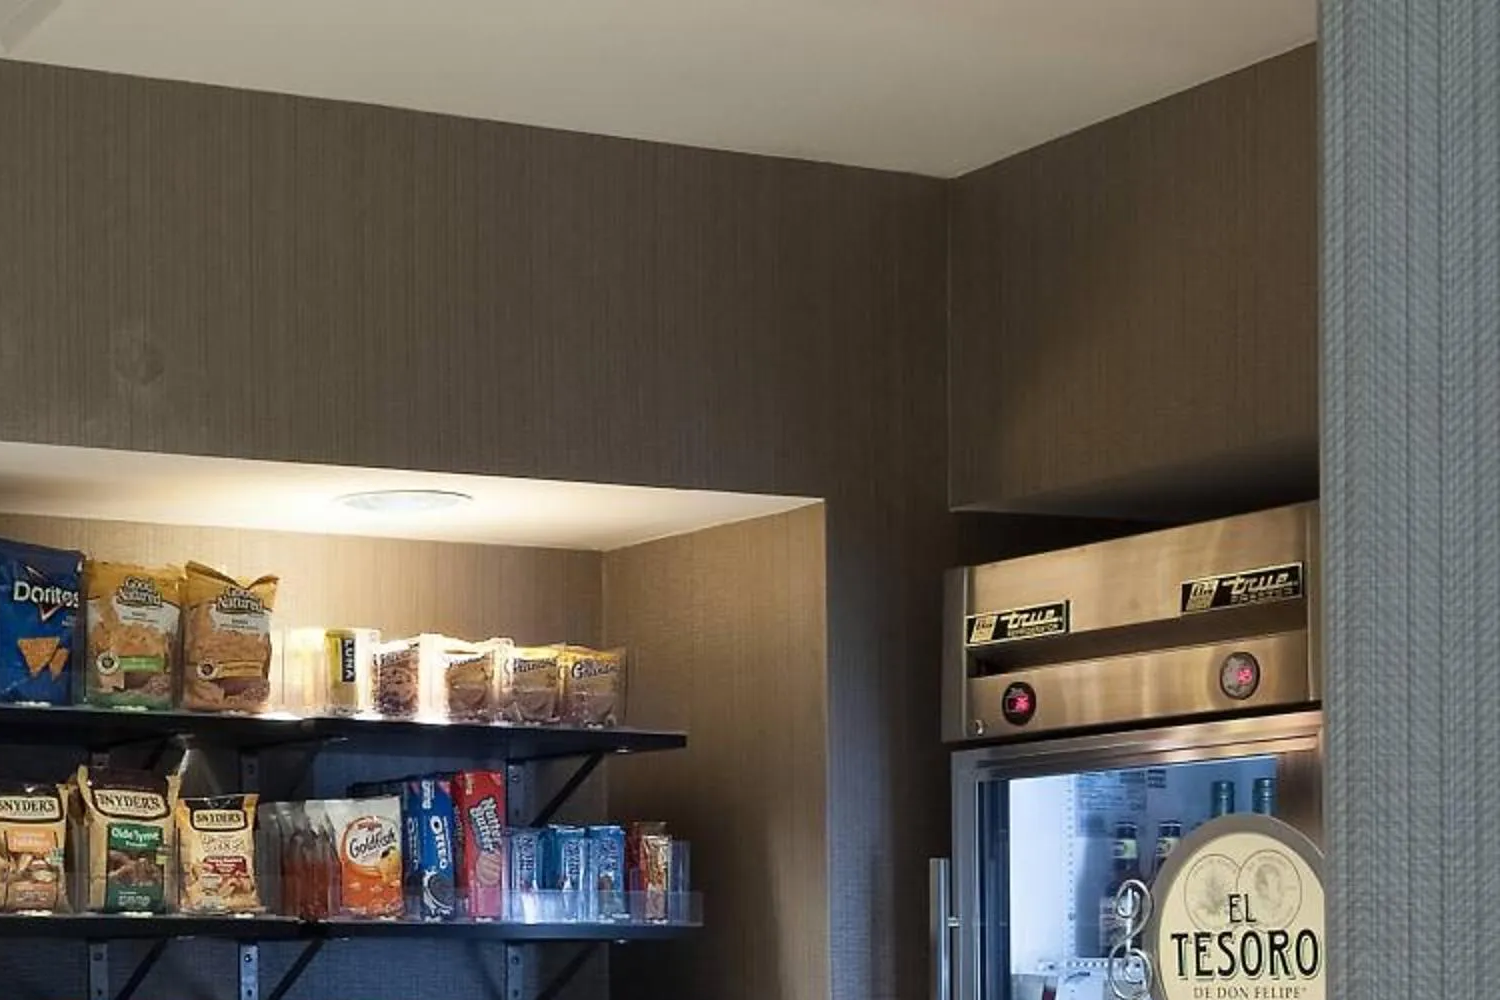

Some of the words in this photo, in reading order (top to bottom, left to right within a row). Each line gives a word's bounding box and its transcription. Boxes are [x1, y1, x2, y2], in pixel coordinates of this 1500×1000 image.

[13, 579, 79, 608] Doritos
[343, 638, 355, 681] LUNA
[349, 827, 397, 859] Goldfish
[1227, 893, 1257, 924] EL
[1170, 928, 1320, 979] TESORO
[1193, 986, 1214, 1000] DE
[1217, 985, 1250, 1000] DON
